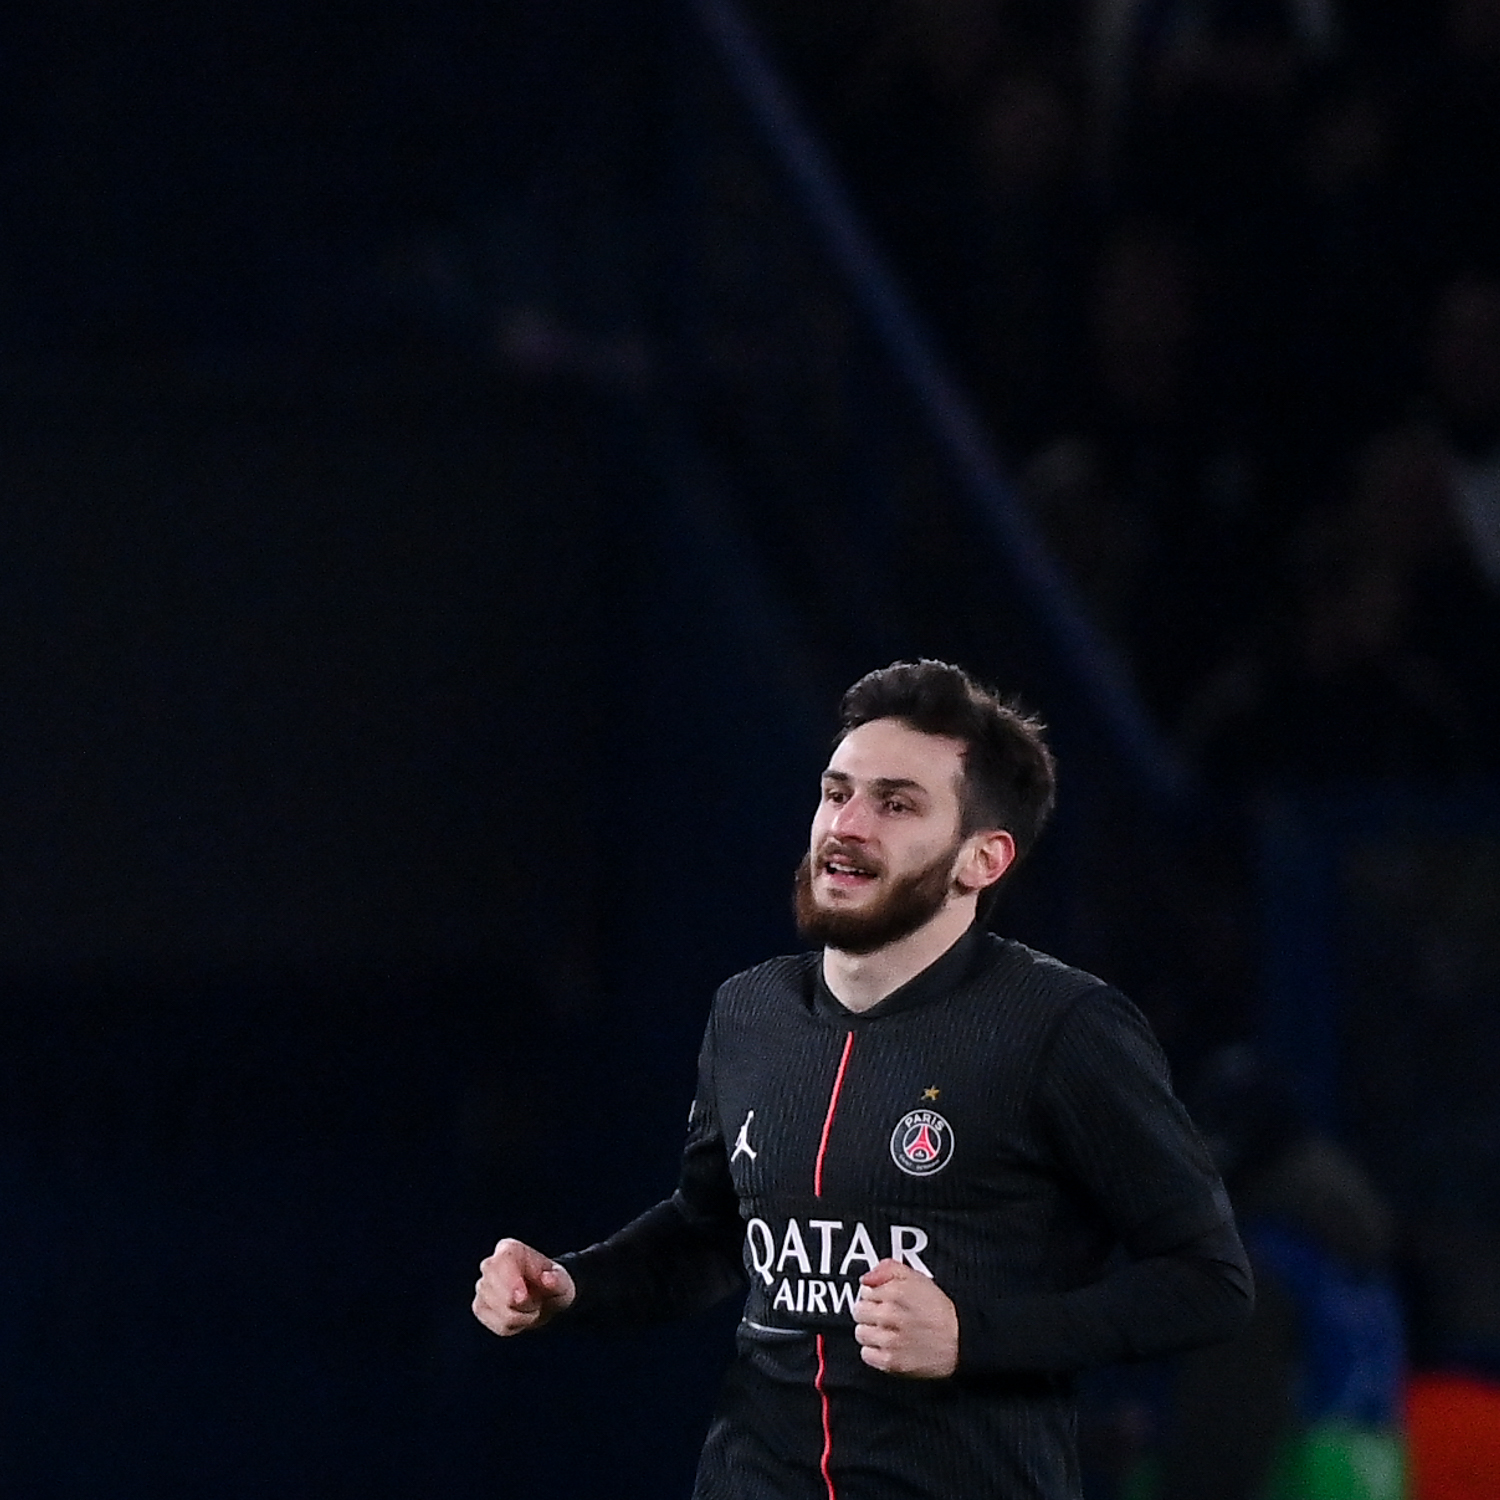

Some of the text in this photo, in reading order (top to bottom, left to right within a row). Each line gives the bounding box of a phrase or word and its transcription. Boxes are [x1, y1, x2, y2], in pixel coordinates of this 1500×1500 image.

[904, 1113, 945, 1131] PARIS
[747, 1217, 935, 1286] QATAR
[773, 1278, 864, 1314] AIRW
